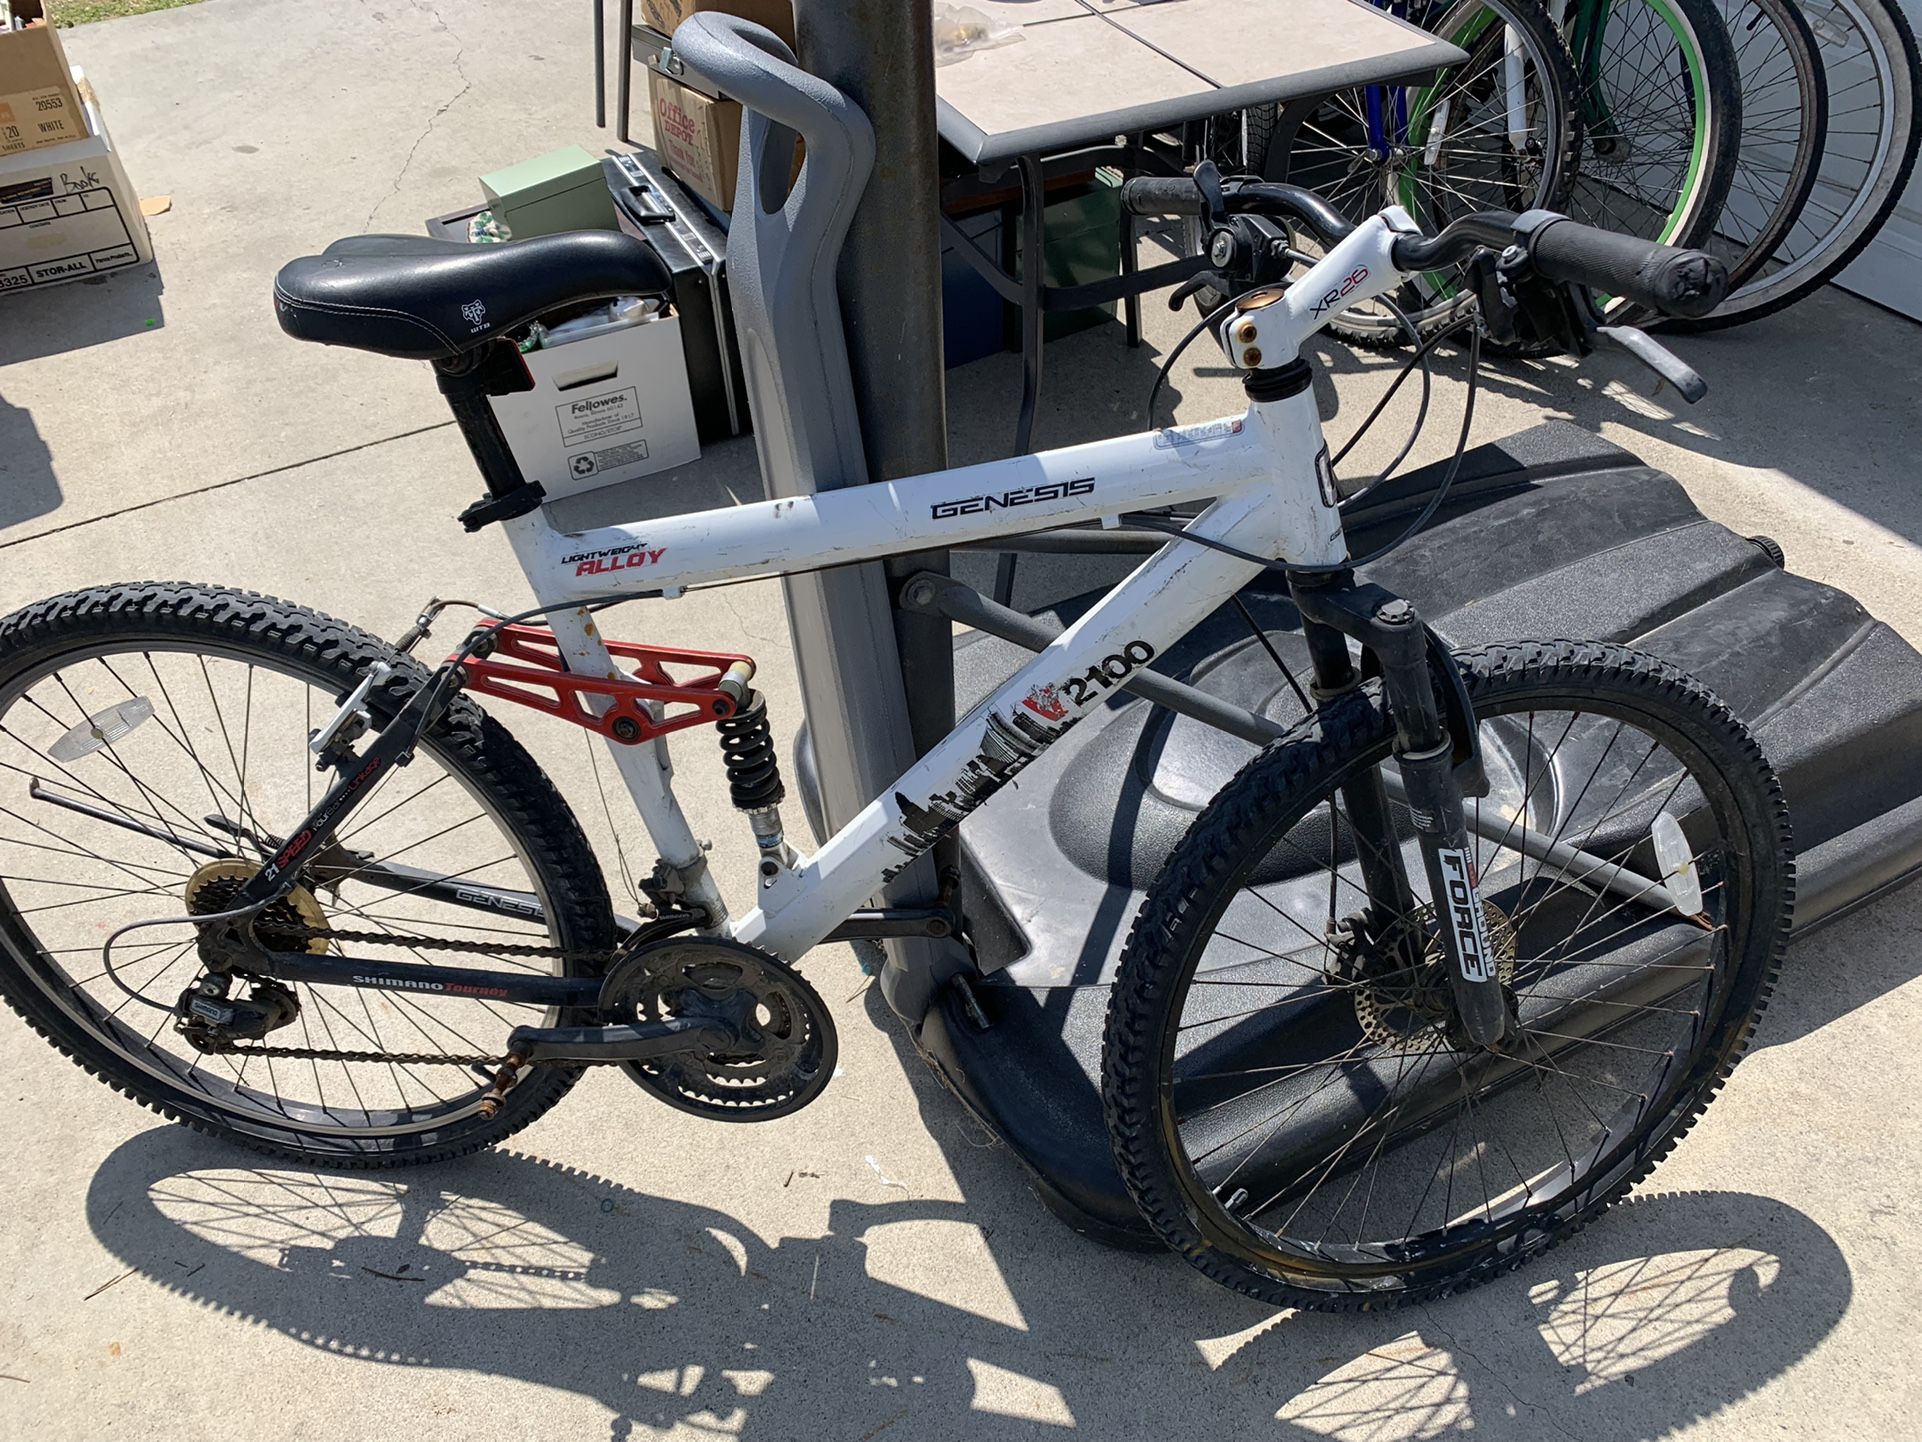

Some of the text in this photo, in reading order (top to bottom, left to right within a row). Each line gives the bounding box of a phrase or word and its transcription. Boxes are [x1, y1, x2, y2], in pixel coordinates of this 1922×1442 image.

[35, 97, 63, 111] 20553
[659, 98, 696, 133] Office
[37, 120, 65, 133] WHITE
[664, 121, 694, 146] DEPOT
[36, 261, 87, 278] STOR-ALL
[1309, 268, 1369, 320] XR26
[930, 477, 1095, 520] GENESIS
[575, 547, 668, 577] ALLOY
[1443, 853, 1483, 977] FORCE
[1472, 887, 1496, 977] GROUND
